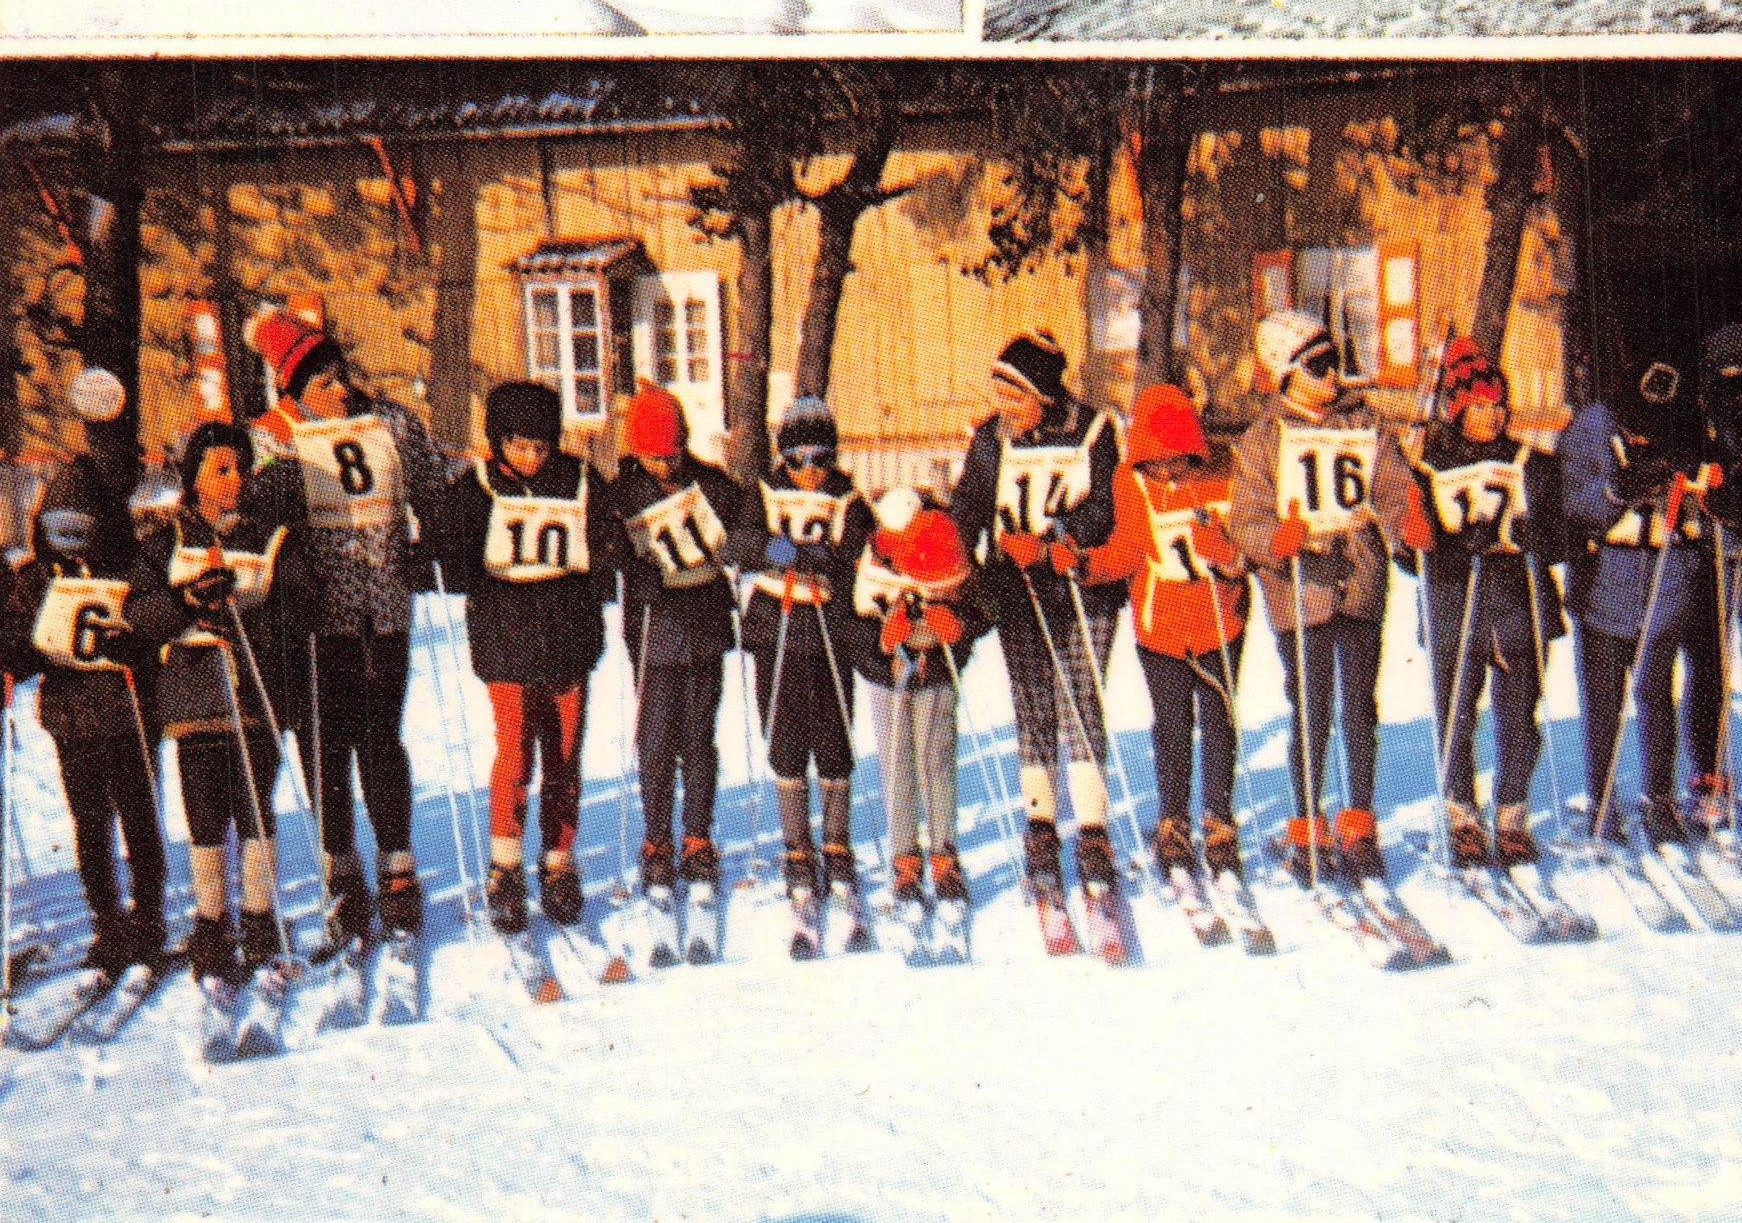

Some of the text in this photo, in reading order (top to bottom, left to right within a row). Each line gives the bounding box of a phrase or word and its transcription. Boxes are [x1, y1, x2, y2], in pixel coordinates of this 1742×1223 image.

[333, 439, 374, 495] 8
[1298, 451, 1365, 512] 16
[505, 519, 568, 568] 10
[74, 603, 111, 663] 6
